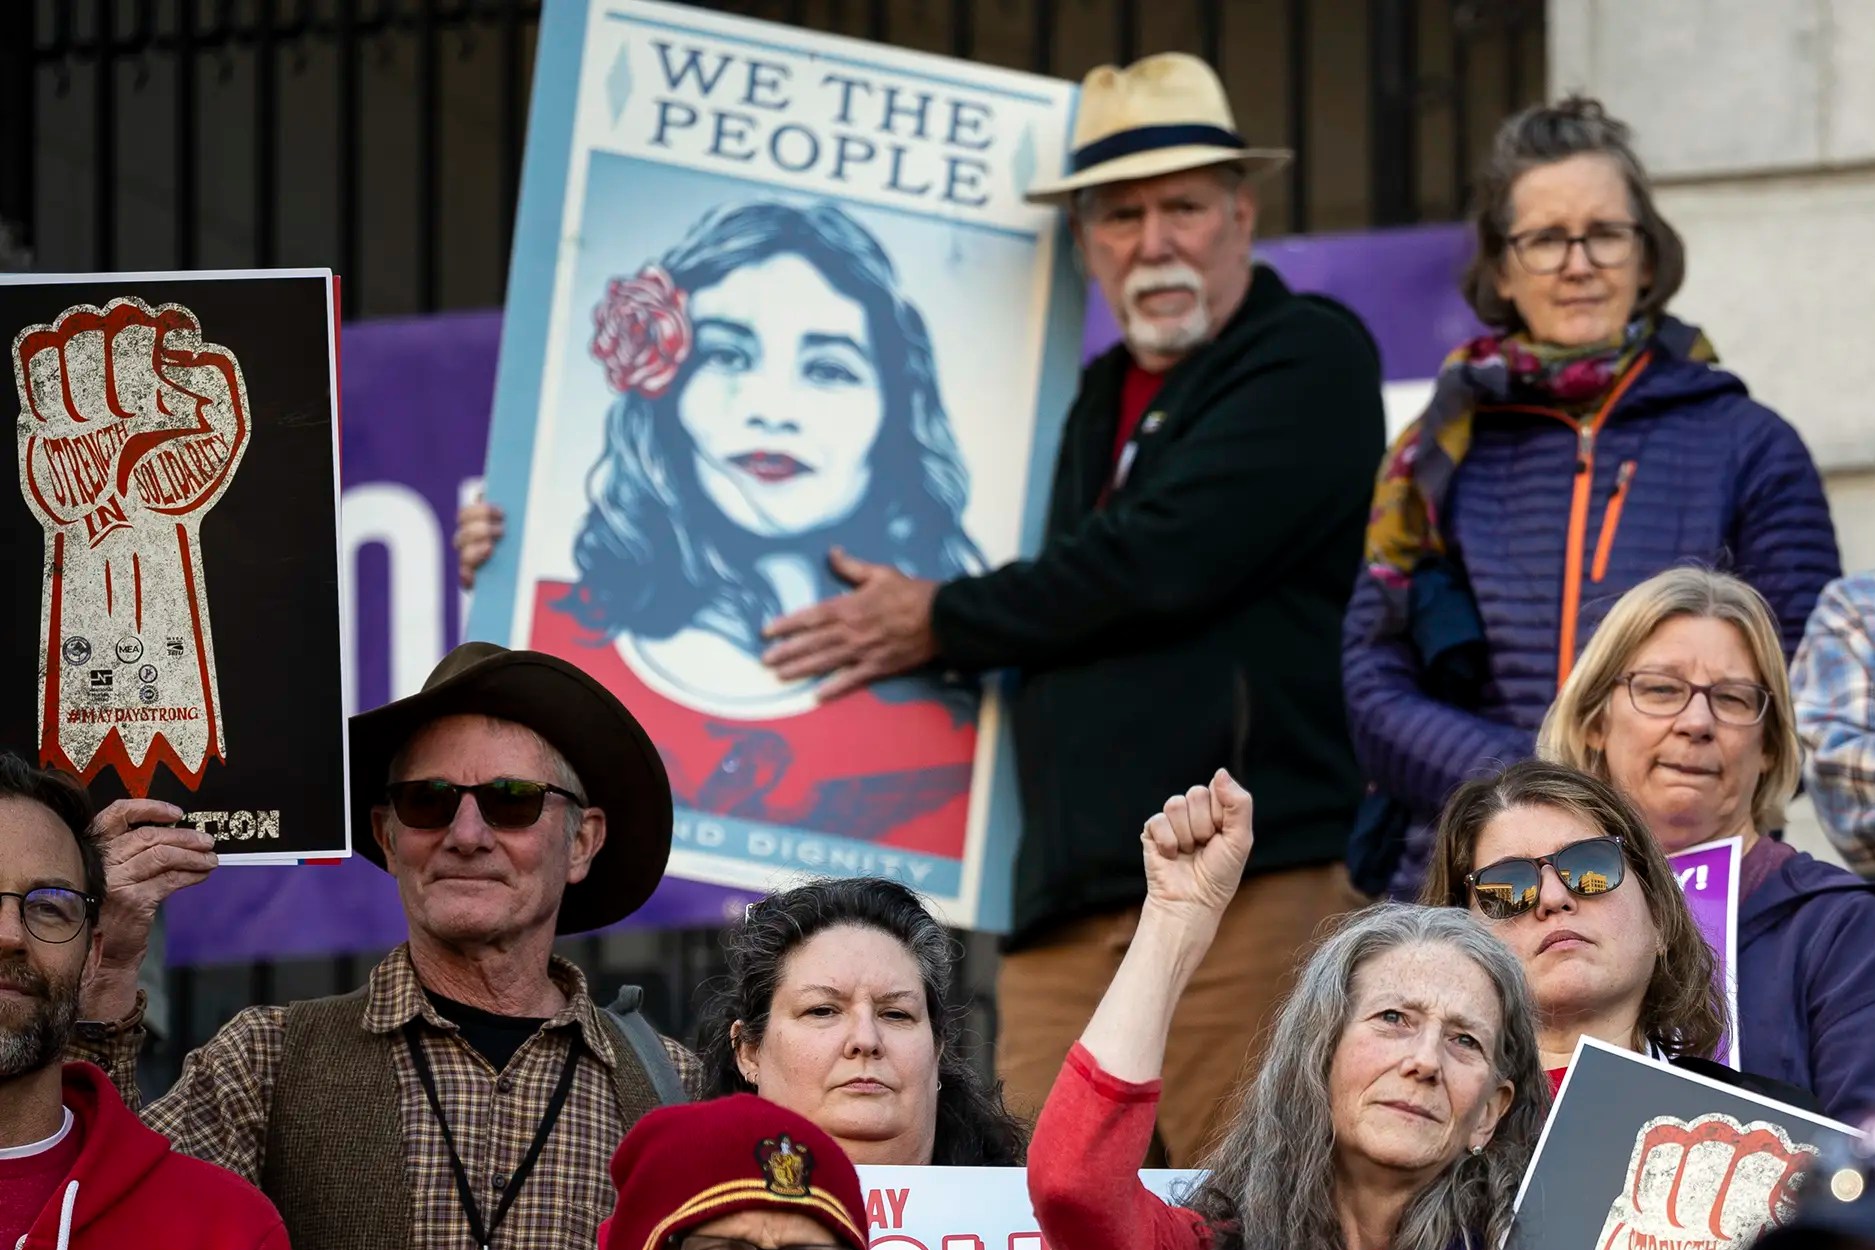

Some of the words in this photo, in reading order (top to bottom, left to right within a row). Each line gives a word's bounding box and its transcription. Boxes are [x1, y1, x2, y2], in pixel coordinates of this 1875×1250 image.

[649, 40, 792, 111] WE
[822, 72, 995, 151] THE
[647, 99, 993, 208] PEOPLE
[43, 420, 128, 507] STRENGTH
[133, 432, 229, 505] SOLIDARITY
[84, 492, 128, 543] IN
[67, 706, 199, 724] #MAYDAYSTRONG
[180, 809, 281, 842] TION
[868, 1188, 911, 1229] AY
